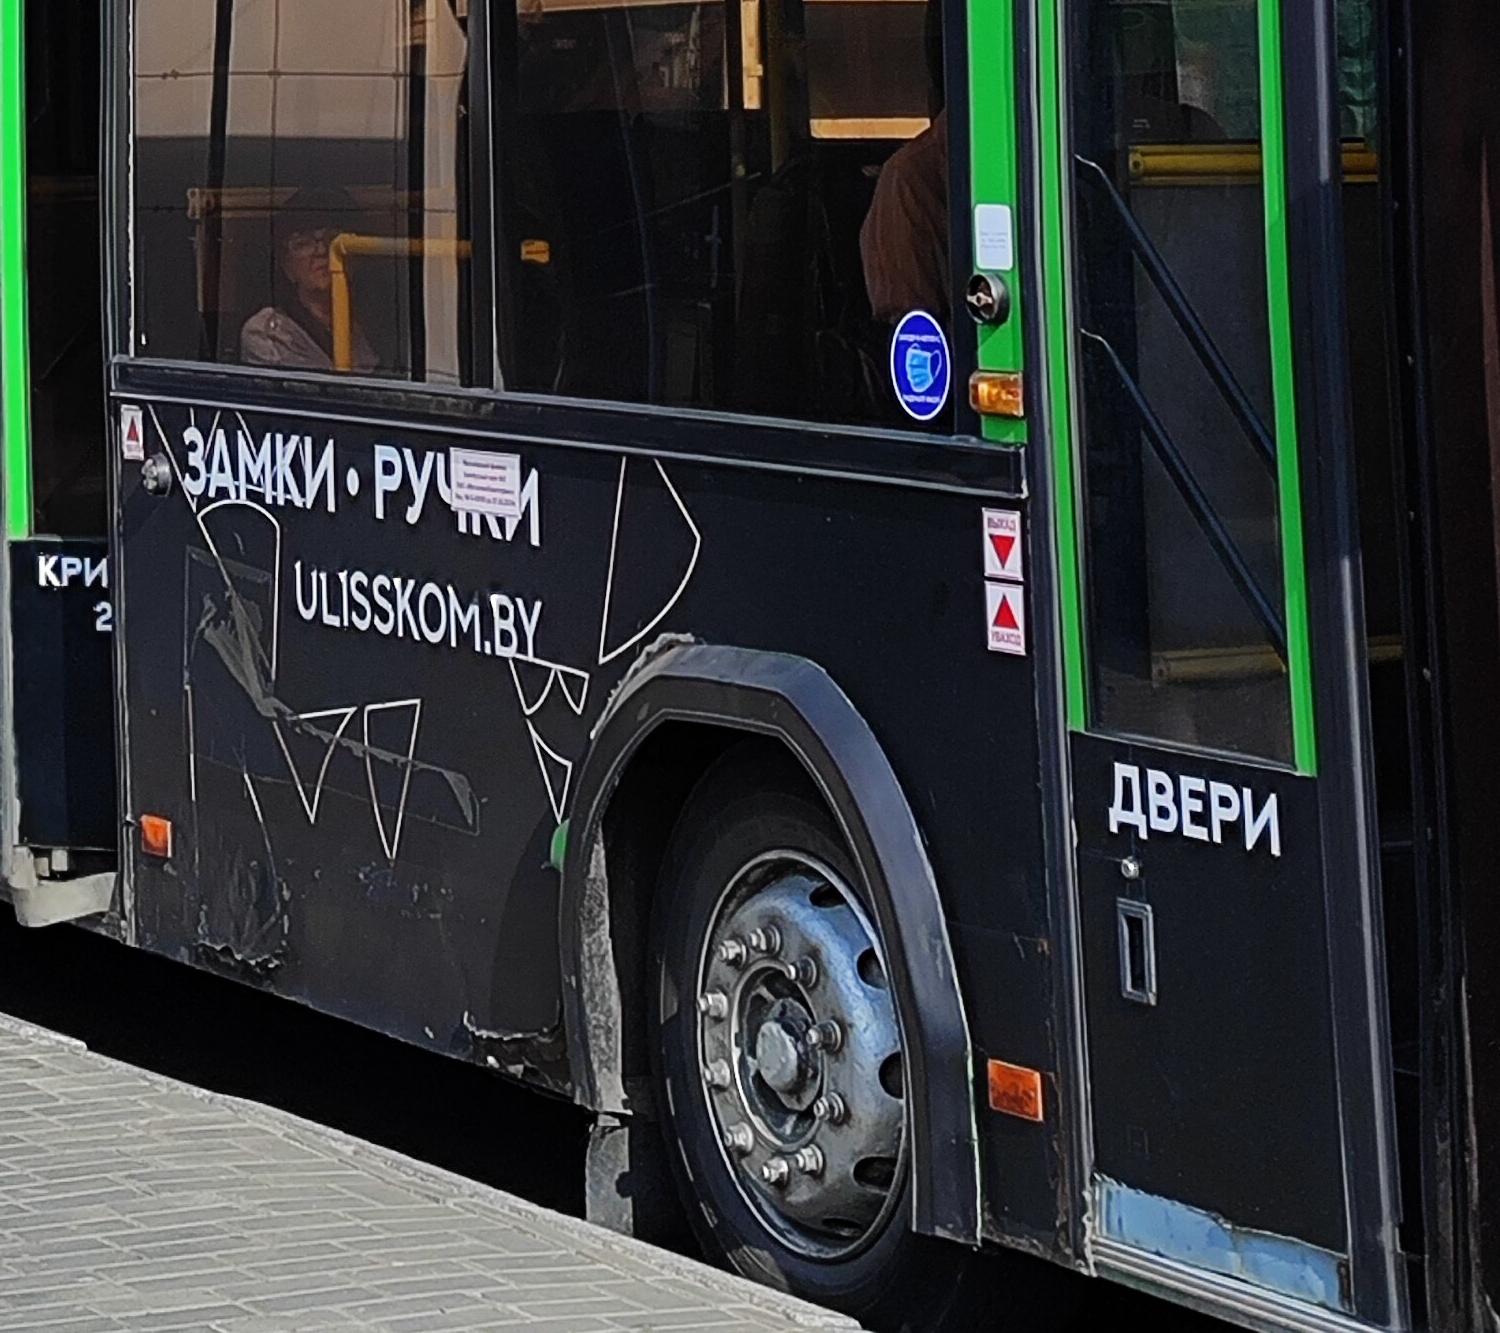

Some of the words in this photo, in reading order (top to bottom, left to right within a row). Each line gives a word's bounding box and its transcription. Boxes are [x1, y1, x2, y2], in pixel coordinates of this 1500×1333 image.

[183, 426, 336, 513] ЗАМКИ
[294, 560, 542, 659] ULISSKOM.BY
[1108, 761, 1282, 858] ДВЕРИ
